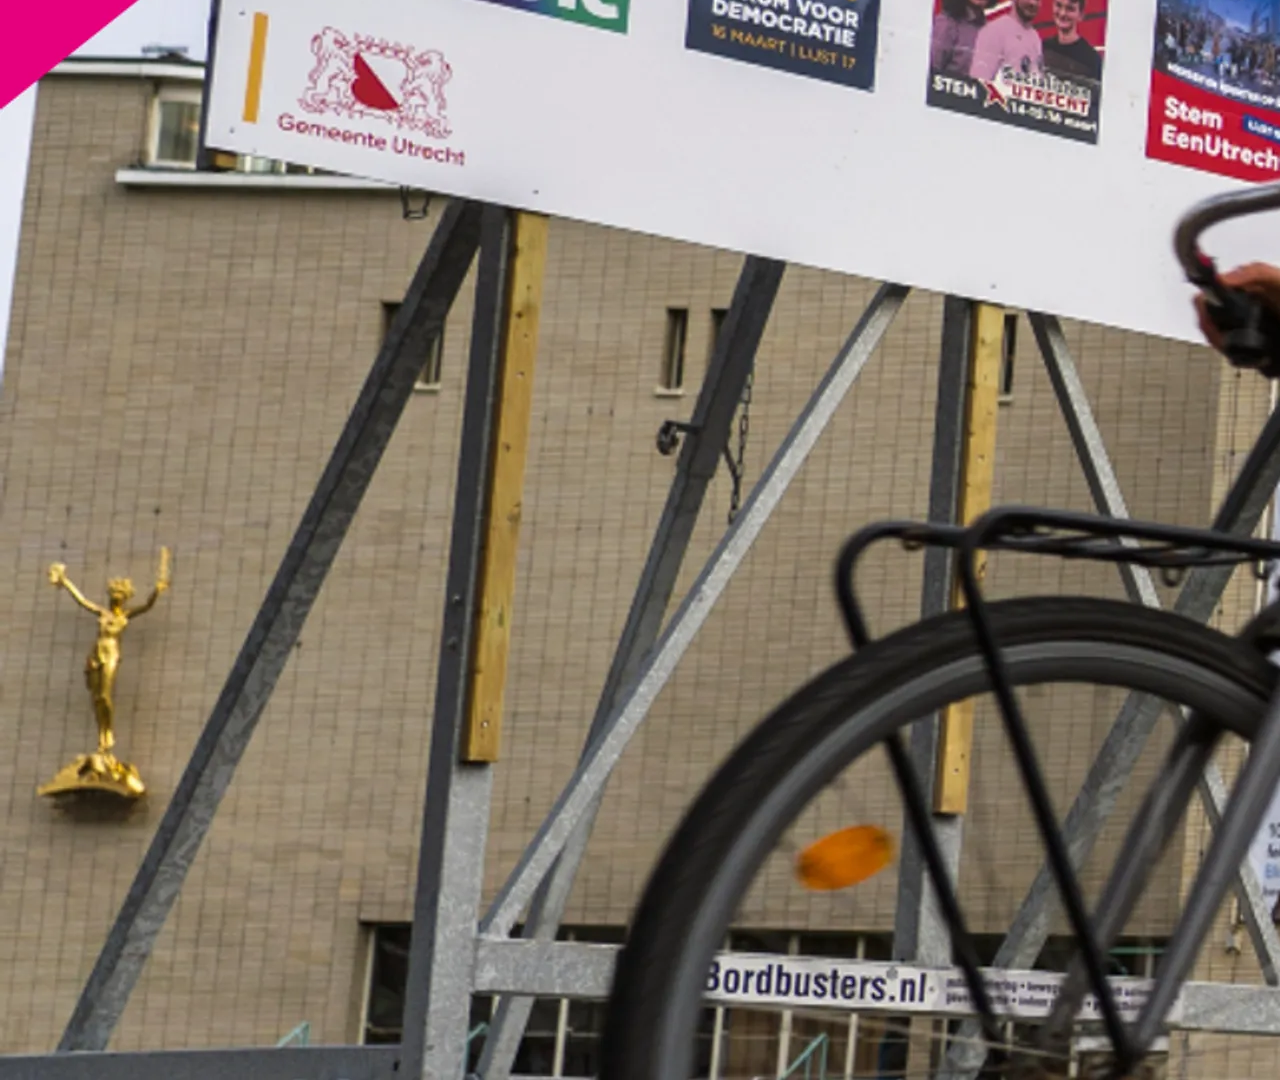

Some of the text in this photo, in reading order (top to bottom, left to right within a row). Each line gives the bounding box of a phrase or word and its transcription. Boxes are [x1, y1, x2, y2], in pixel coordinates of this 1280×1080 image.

[730, 29, 786, 55] MAART
[932, 75, 978, 100] STEM
[1011, 84, 1090, 116] UTRECHT
[1164, 96, 1223, 130] Stem
[277, 112, 465, 166] Gemeente Utrecht
